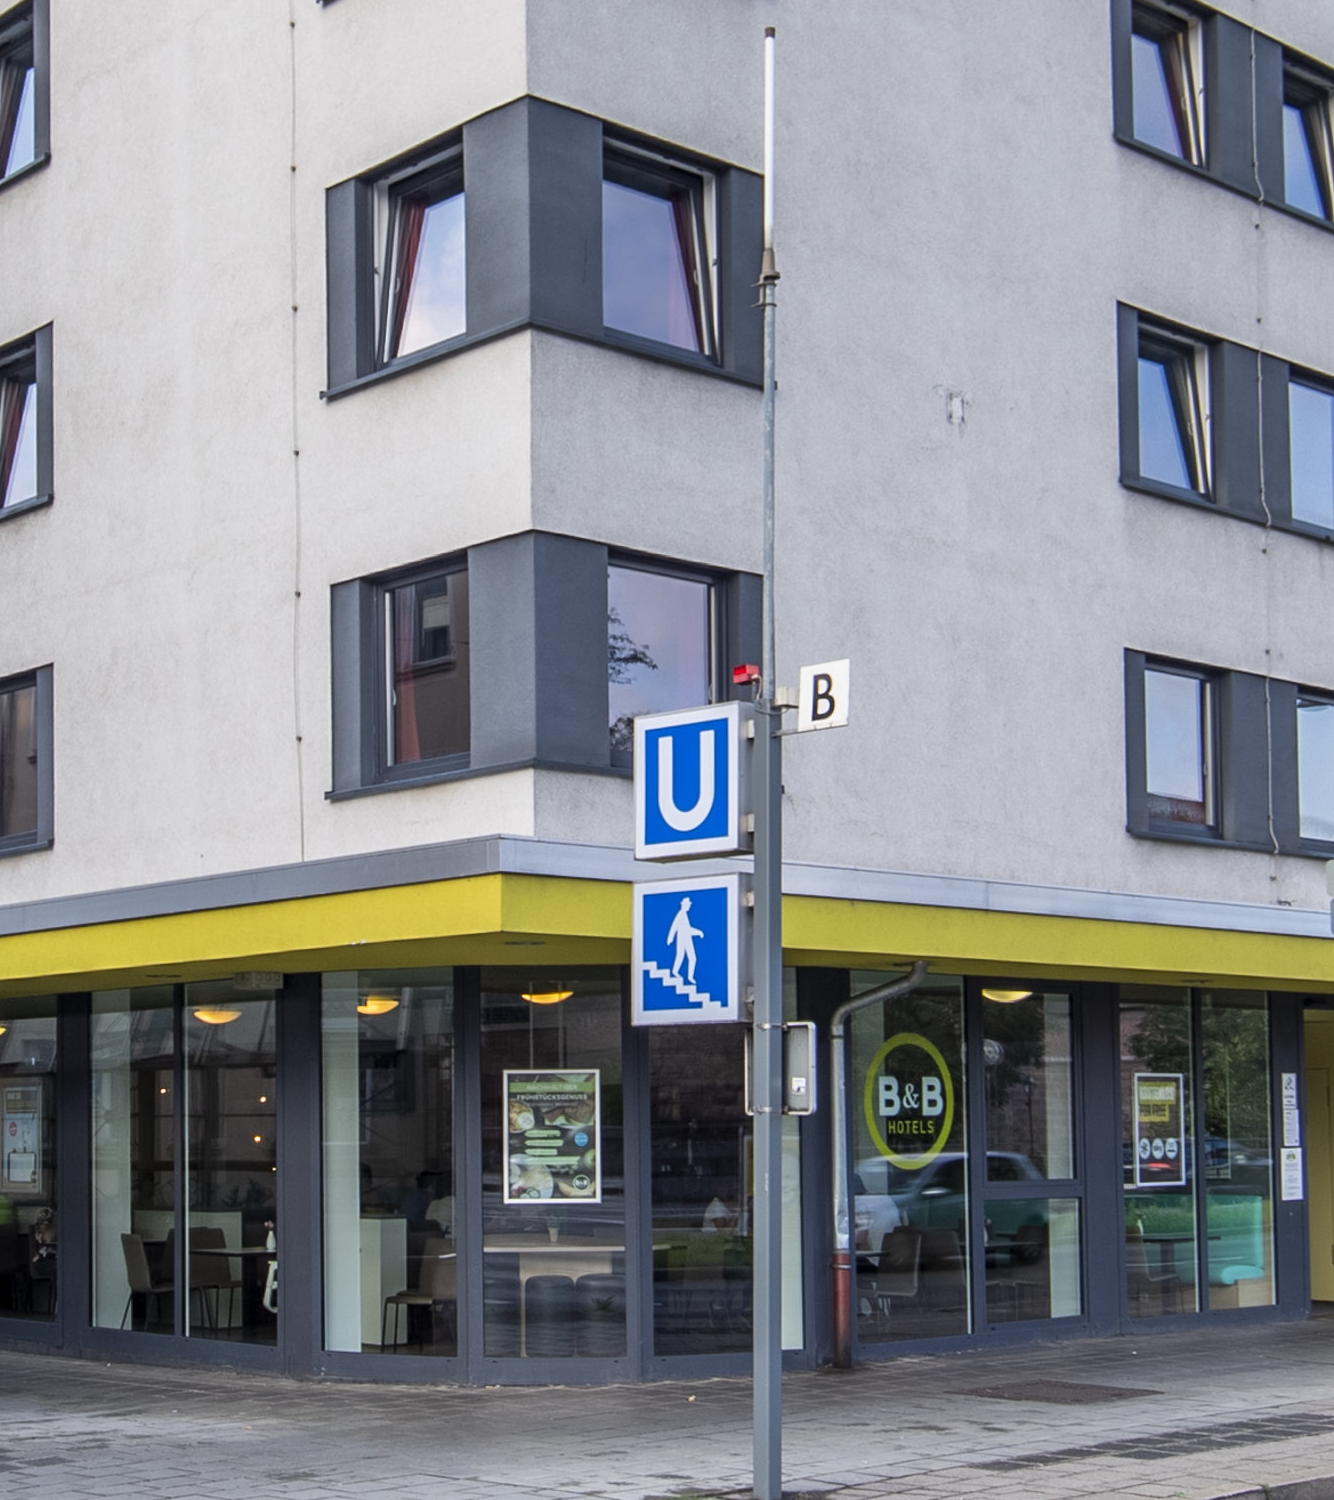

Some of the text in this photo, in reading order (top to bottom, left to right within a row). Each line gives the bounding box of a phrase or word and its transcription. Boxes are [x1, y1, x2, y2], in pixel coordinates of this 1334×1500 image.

[811, 673, 836, 722] B
[658, 729, 715, 832] U
[878, 1076, 944, 1116] B&B
[888, 1120, 935, 1134] HOTELS
